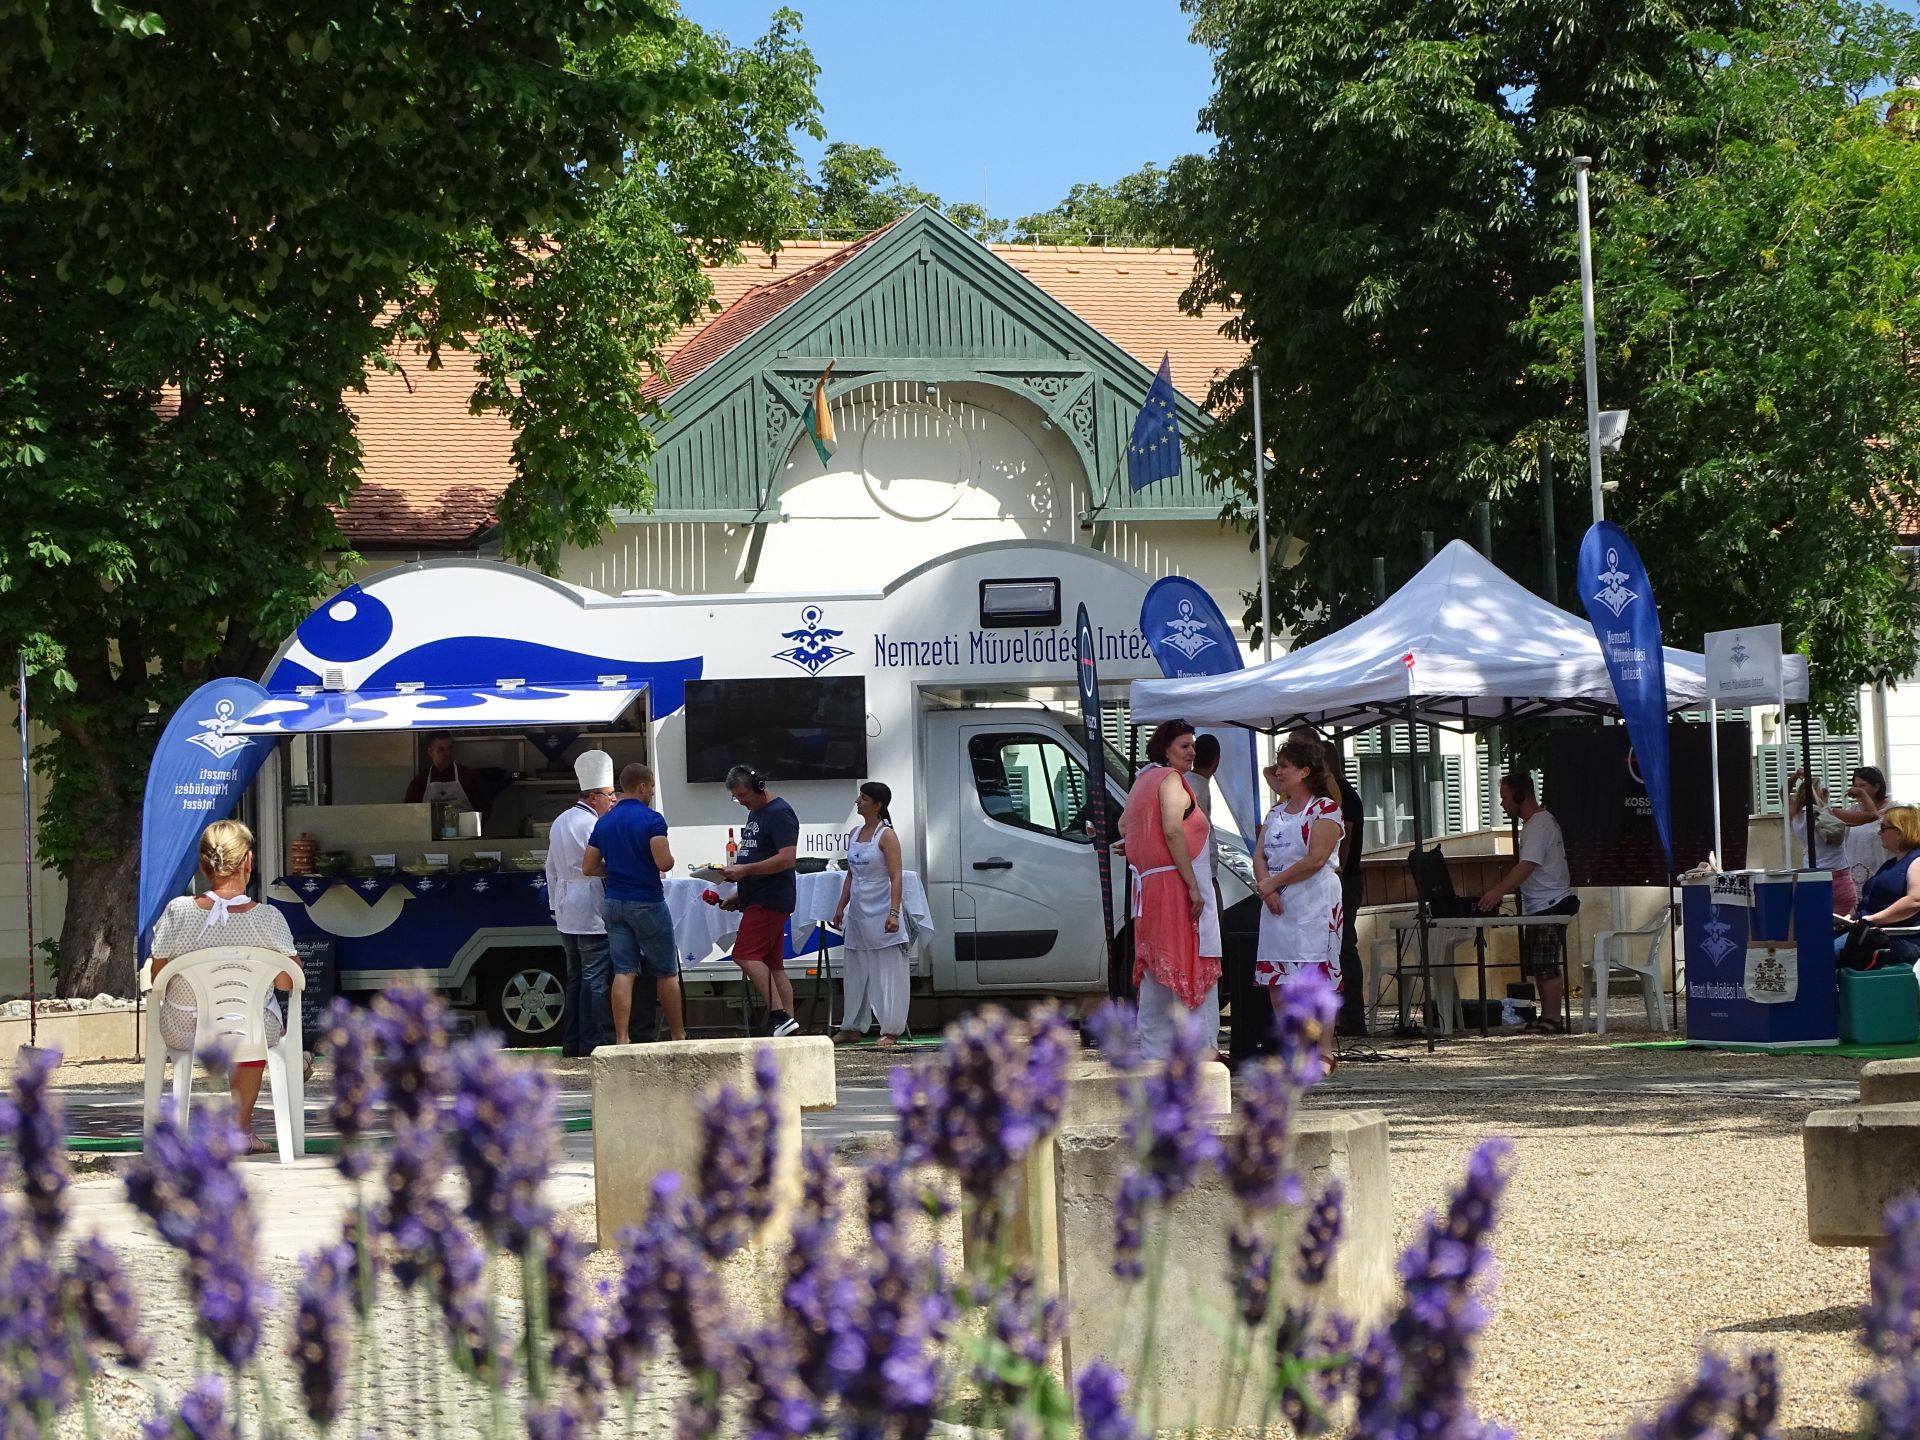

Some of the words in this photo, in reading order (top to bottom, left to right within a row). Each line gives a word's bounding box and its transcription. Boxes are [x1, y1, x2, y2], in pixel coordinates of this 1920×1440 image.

[1606, 630, 1630, 645] Nemzeti
[874, 633, 960, 667] Nemzeti
[968, 629, 1077, 666] Művelődés
[1098, 627, 1151, 660] Intéz
[1625, 797, 1651, 807] KOSS
[1636, 806, 1652, 815] RÁD
[806, 833, 850, 852] HAGYO
